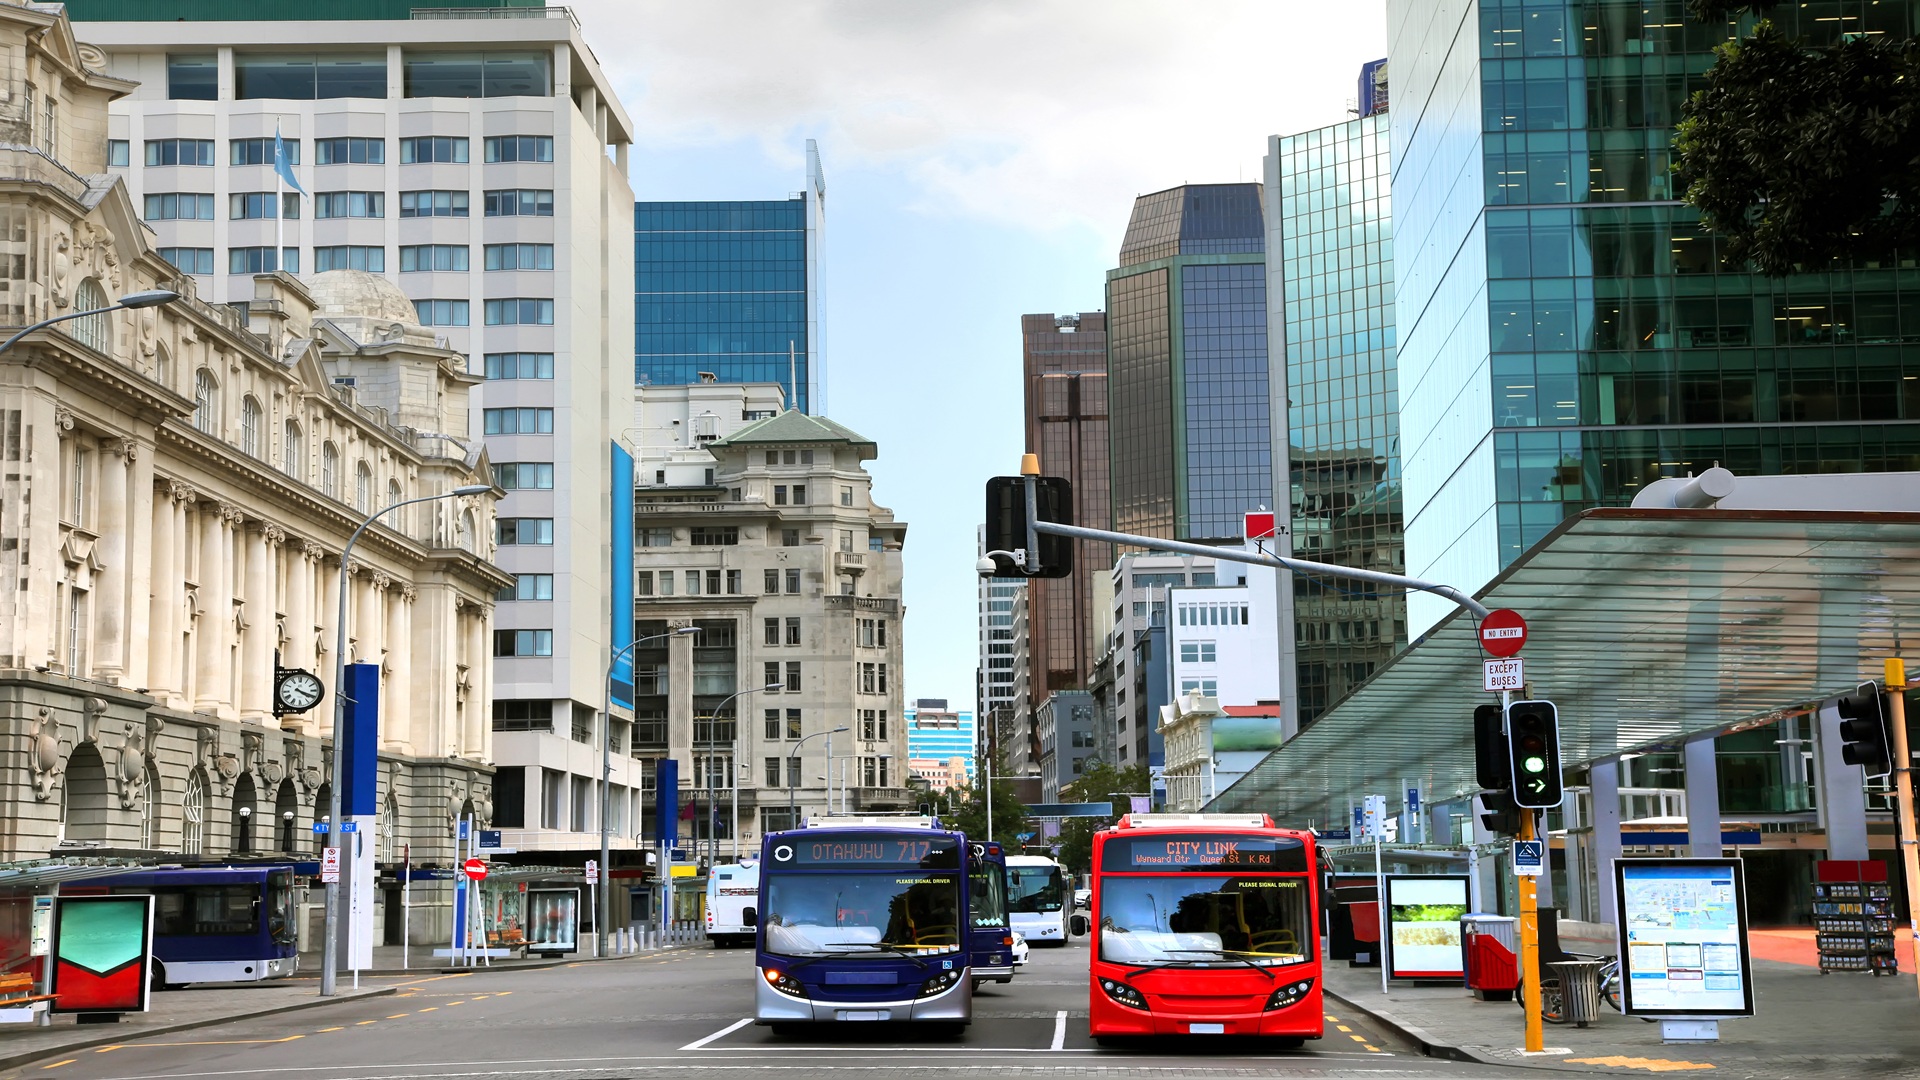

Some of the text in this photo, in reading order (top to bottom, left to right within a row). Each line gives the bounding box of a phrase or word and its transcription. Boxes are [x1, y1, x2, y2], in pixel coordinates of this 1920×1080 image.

[1500, 629, 1518, 637] ENTRY
[1489, 663, 1518, 674] EXCEPT
[1491, 676, 1517, 686] BUSES
[812, 841, 930, 861] OTAHUHU 717
[1166, 842, 1239, 855] CITY LINK
[1136, 855, 1271, 863] Wynyard Qtr Queen St K Rd
